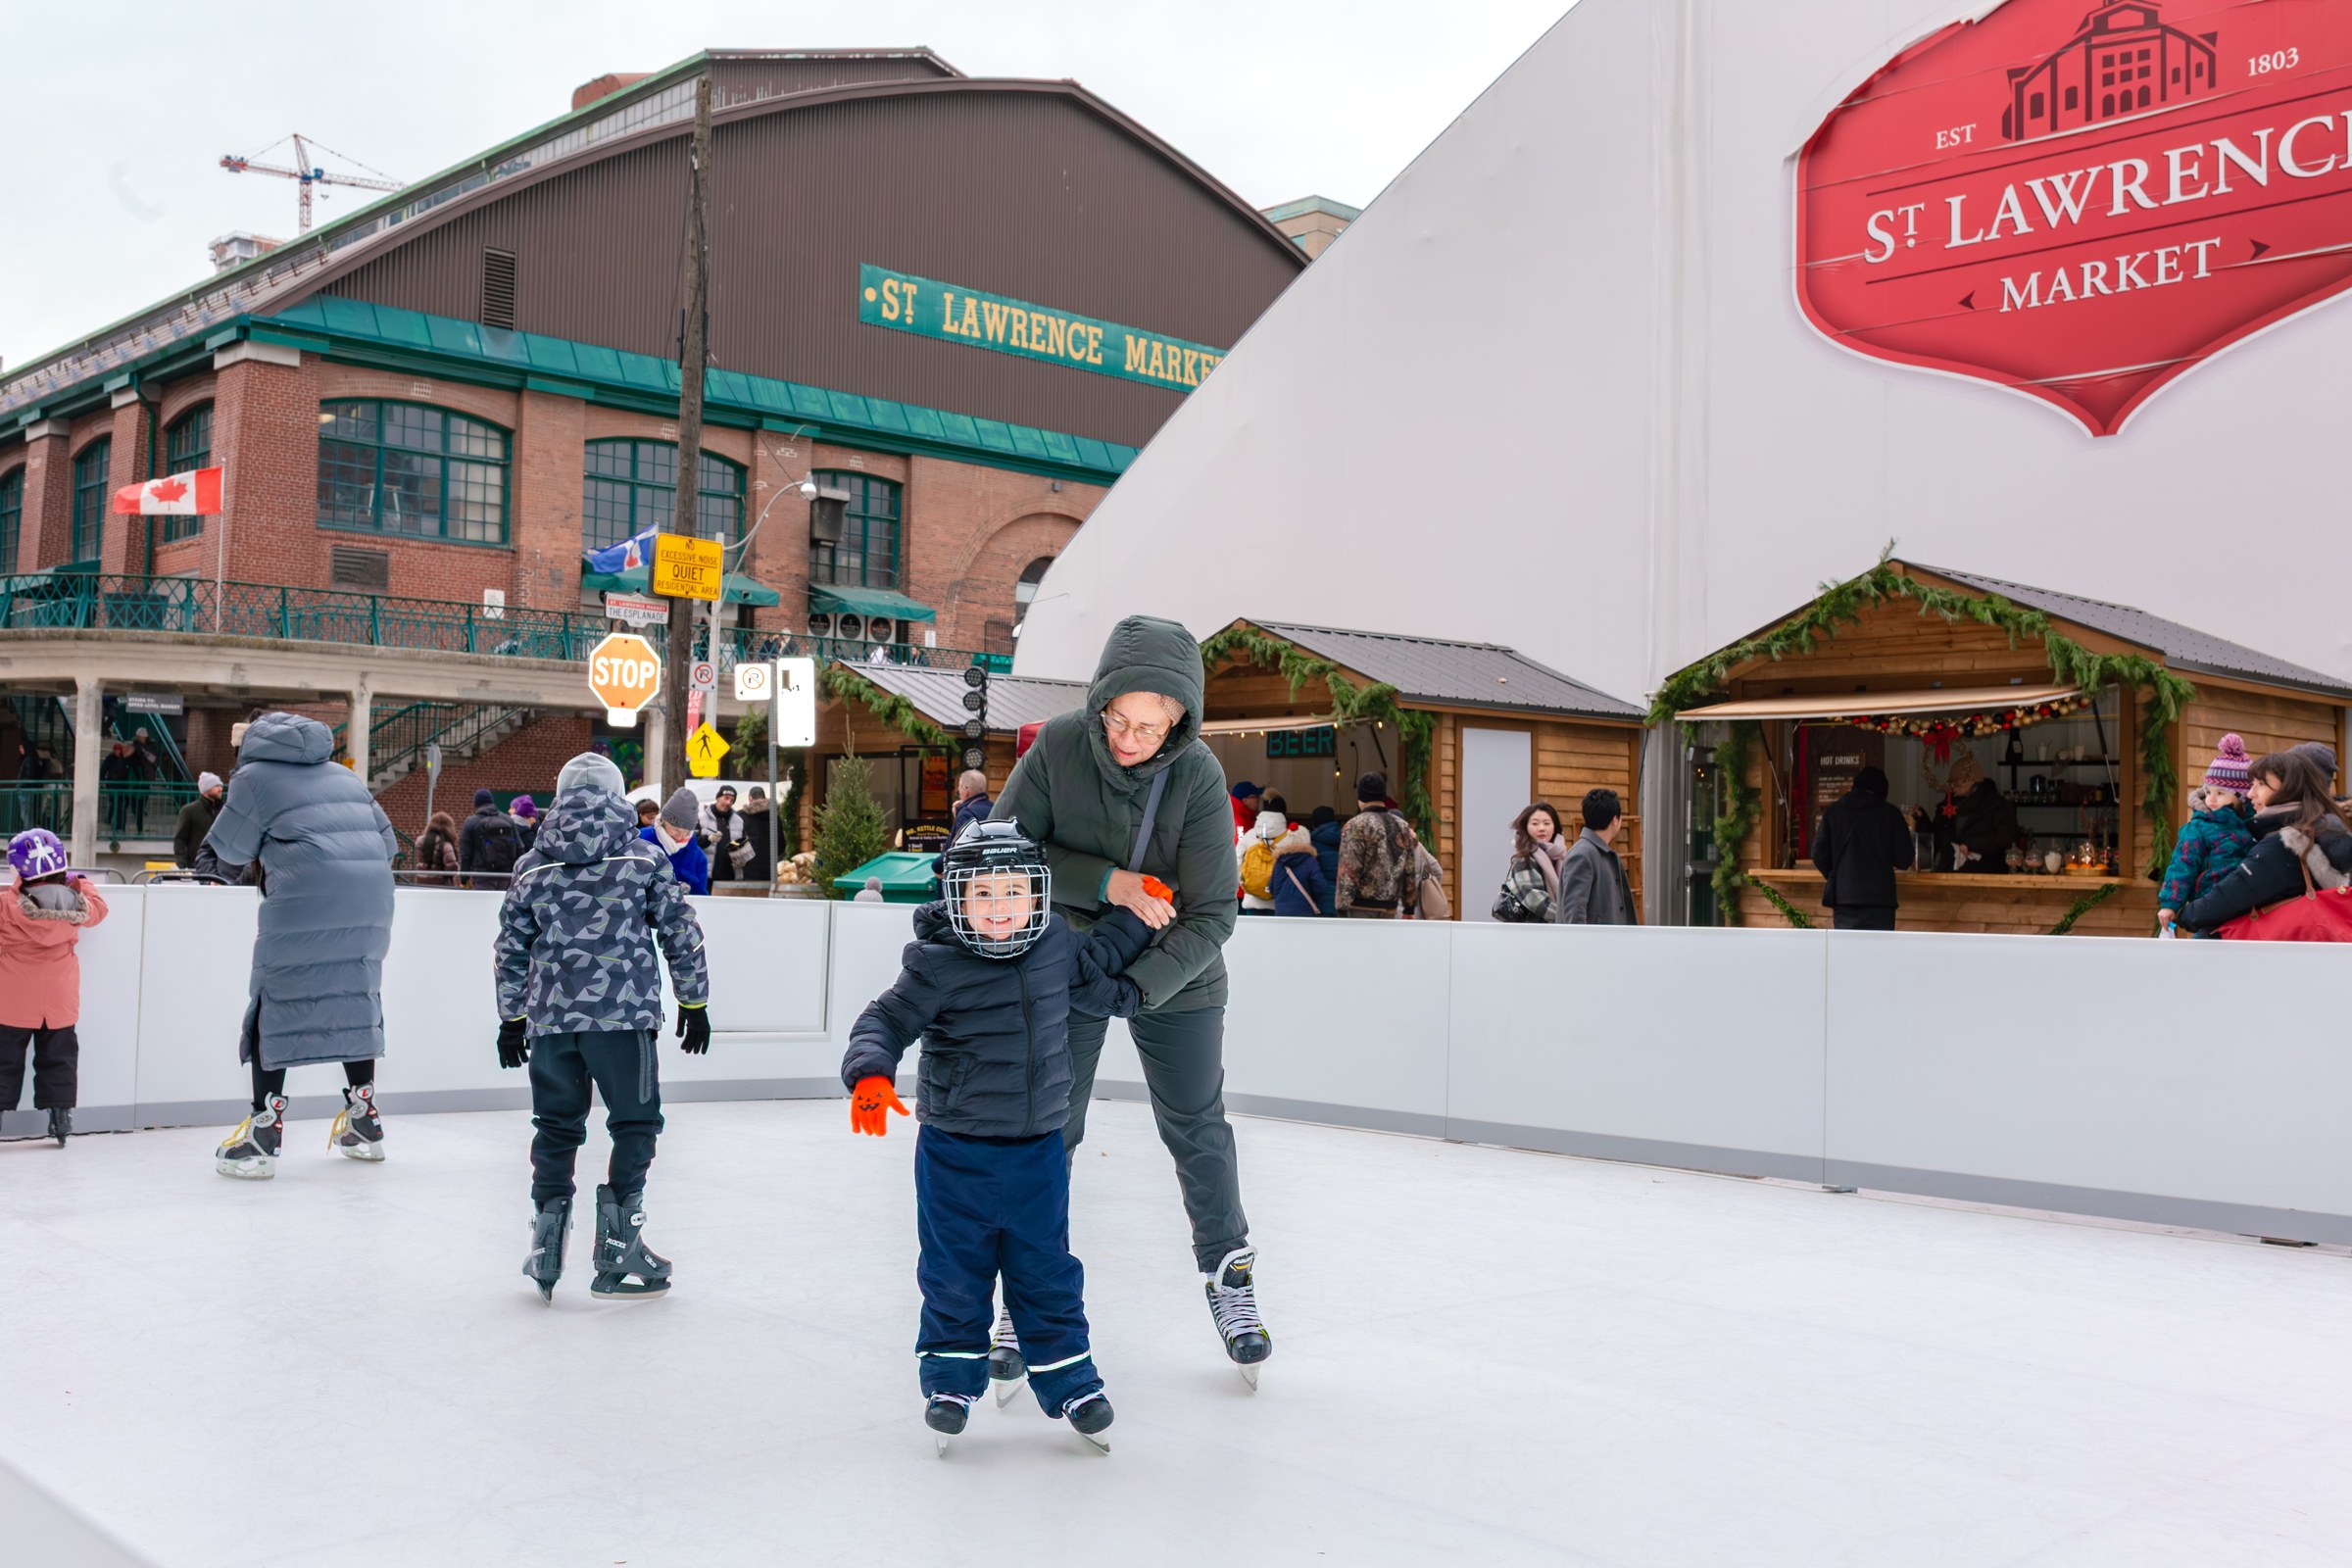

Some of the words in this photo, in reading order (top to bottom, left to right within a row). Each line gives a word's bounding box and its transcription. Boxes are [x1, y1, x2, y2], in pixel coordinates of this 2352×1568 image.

[2248, 47, 2300, 76] 1803
[1935, 122, 1977, 150] EST
[1999, 236, 2221, 313] MARKET
[943, 292, 1102, 365] LAWRENCE
[1125, 334, 1223, 386] MARKE
[662, 550, 697, 563] EXCESSIVE
[699, 556, 718, 565] NOISE
[686, 542, 695, 551] NO
[672, 564, 705, 581] QUIET
[657, 580, 697, 593] RESIDENTIAL
[701, 586, 718, 596] AREA
[610, 607, 622, 617] THE
[624, 609, 664, 621] ESPLANADE
[595, 657, 655, 688] STOP
[1269, 726, 1334, 756] BEER
[1820, 756, 1834, 765] HOT
[1835, 756, 1860, 765] DRINKS
